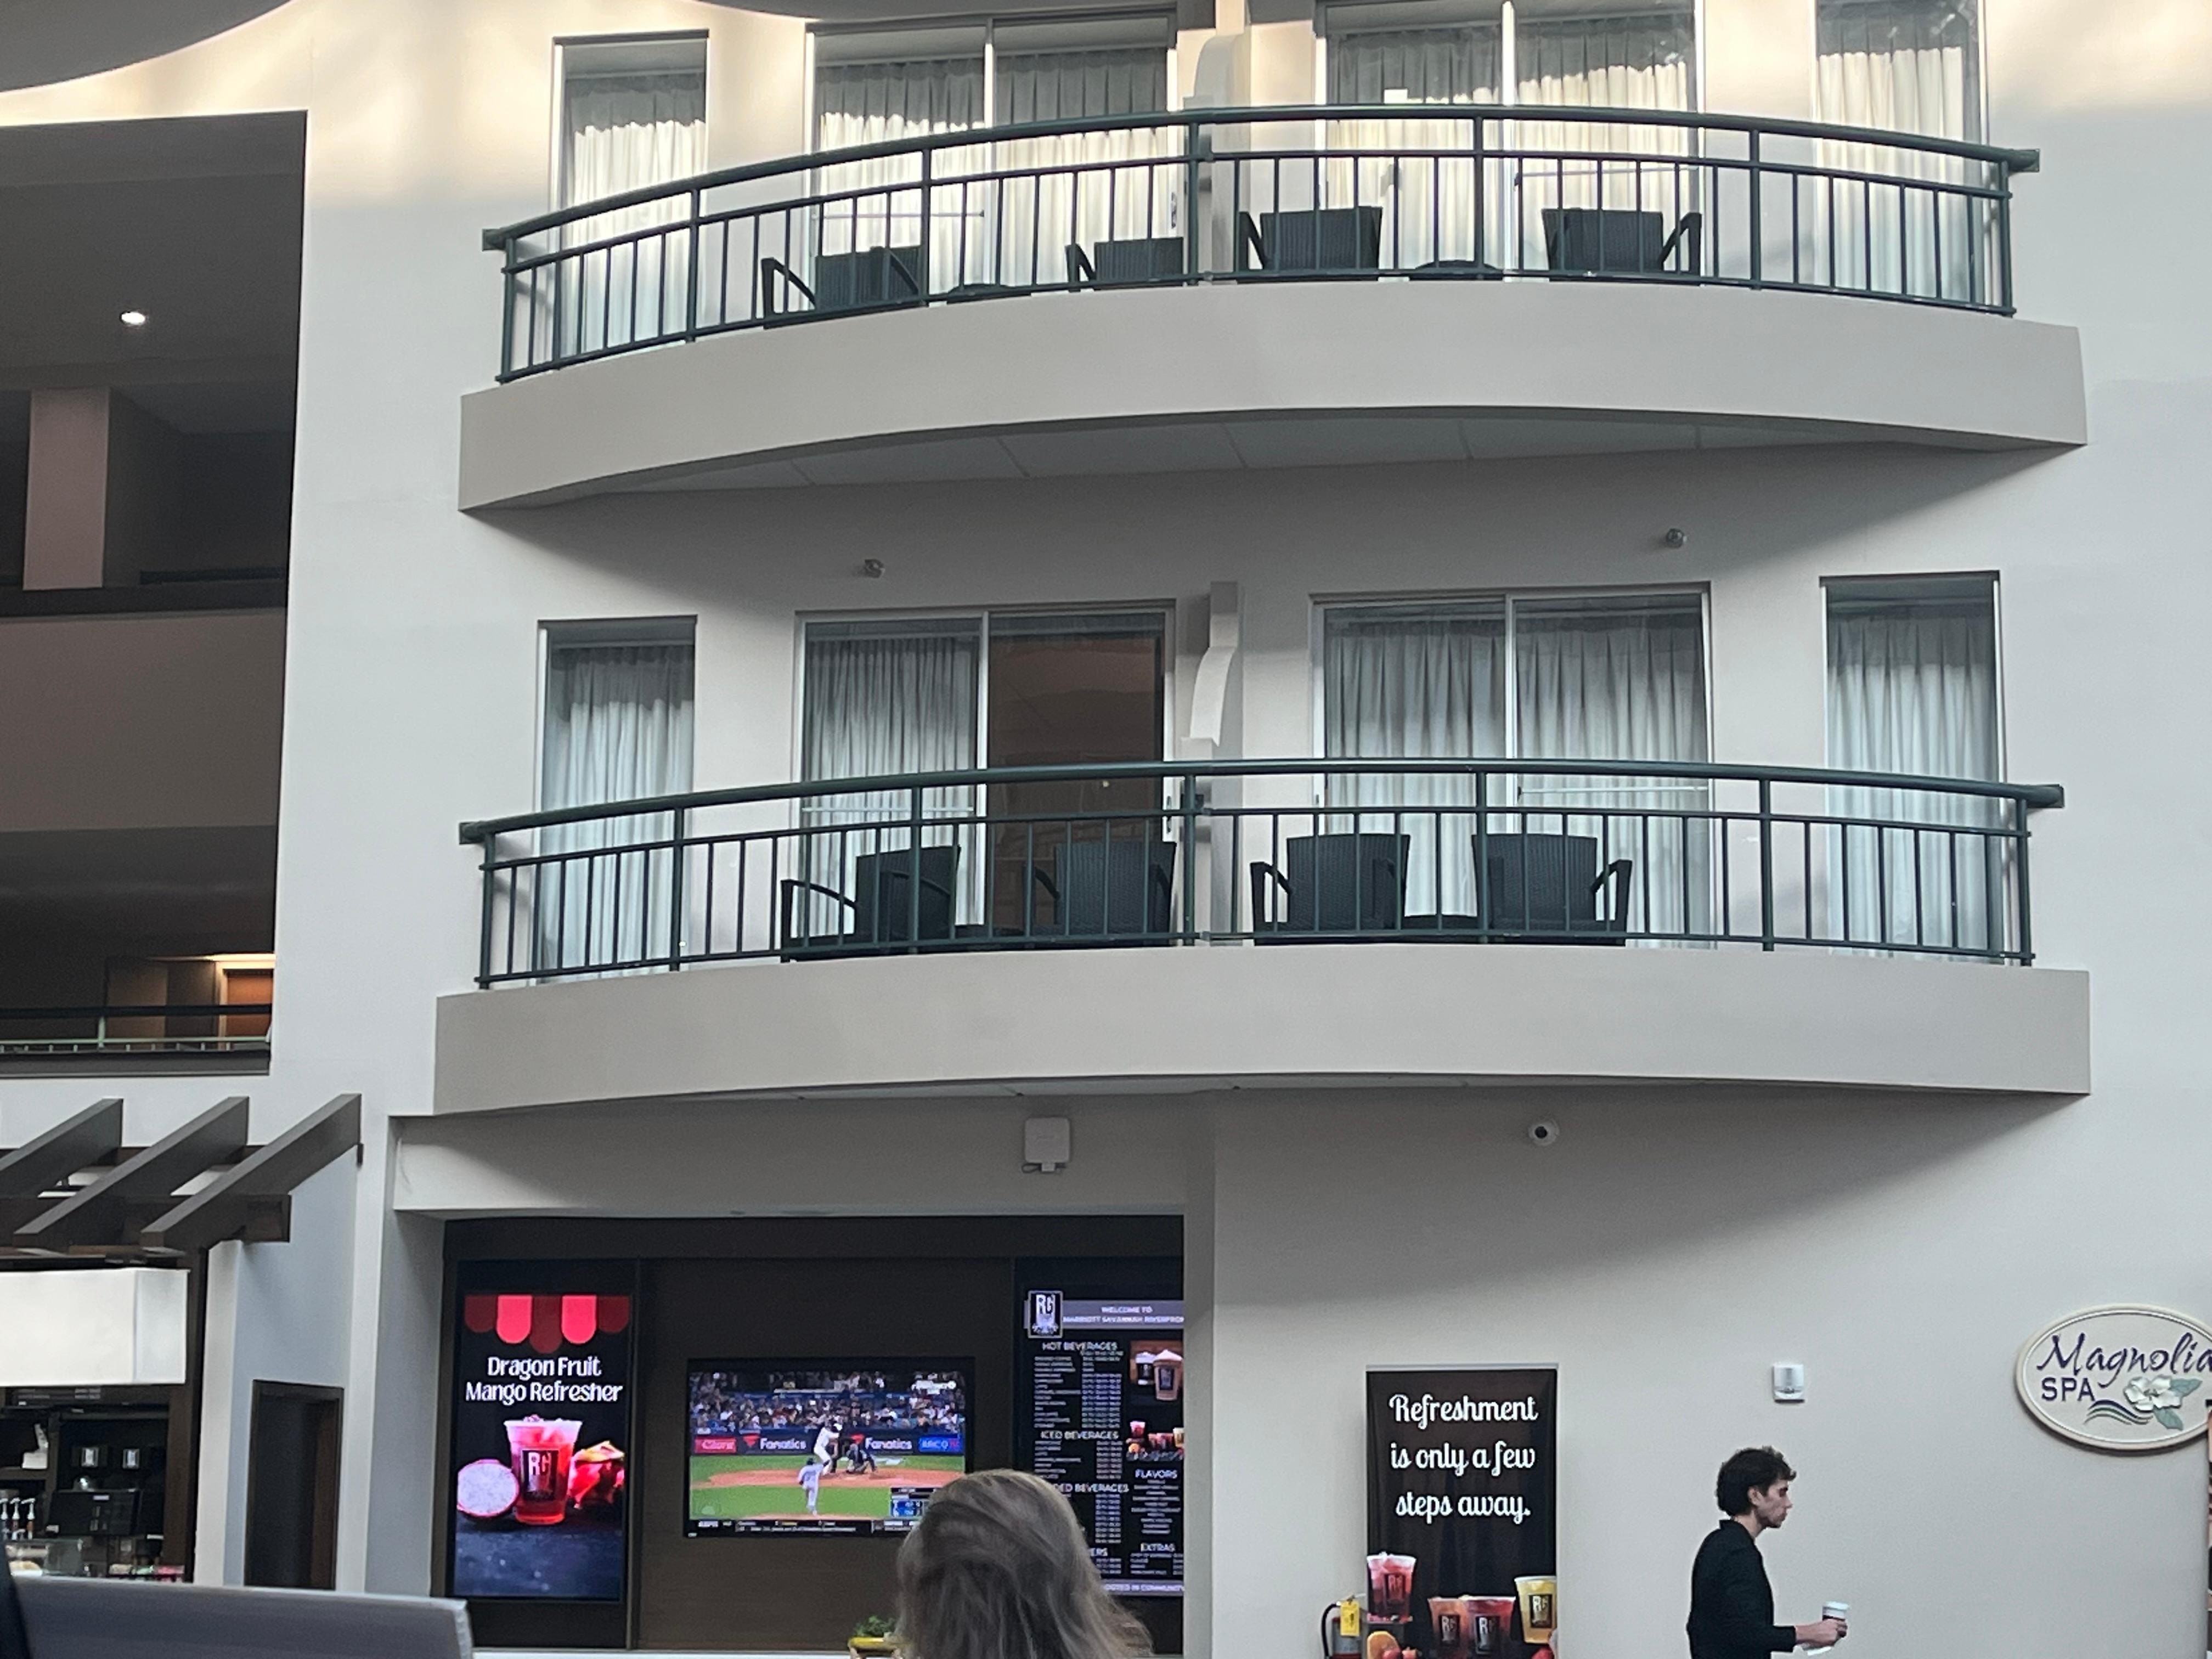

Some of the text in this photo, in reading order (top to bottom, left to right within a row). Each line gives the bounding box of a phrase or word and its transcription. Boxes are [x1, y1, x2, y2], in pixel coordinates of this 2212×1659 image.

[1042, 1342, 1118, 1350] HOT BEVERAGES
[487, 1356, 601, 1380] Dragon Fruit
[2036, 1333, 2212, 1388] Magnolia
[466, 1380, 623, 1406] Mango Refresher
[2041, 1378, 2096, 1402] SPA
[1389, 1393, 1539, 1430] Refreshment
[760, 1438, 806, 1449] Fanatics
[865, 1437, 912, 1449] Fanatics
[1064, 1431, 1119, 1439] BEVERAGES
[1391, 1441, 1536, 1476] is only a few
[1135, 1469, 1177, 1479] FLAVORS
[1075, 1483, 1129, 1493] BEVERAGES
[1396, 1491, 1531, 1525] steps away.
[1141, 1543, 1175, 1552] EXTRAS
